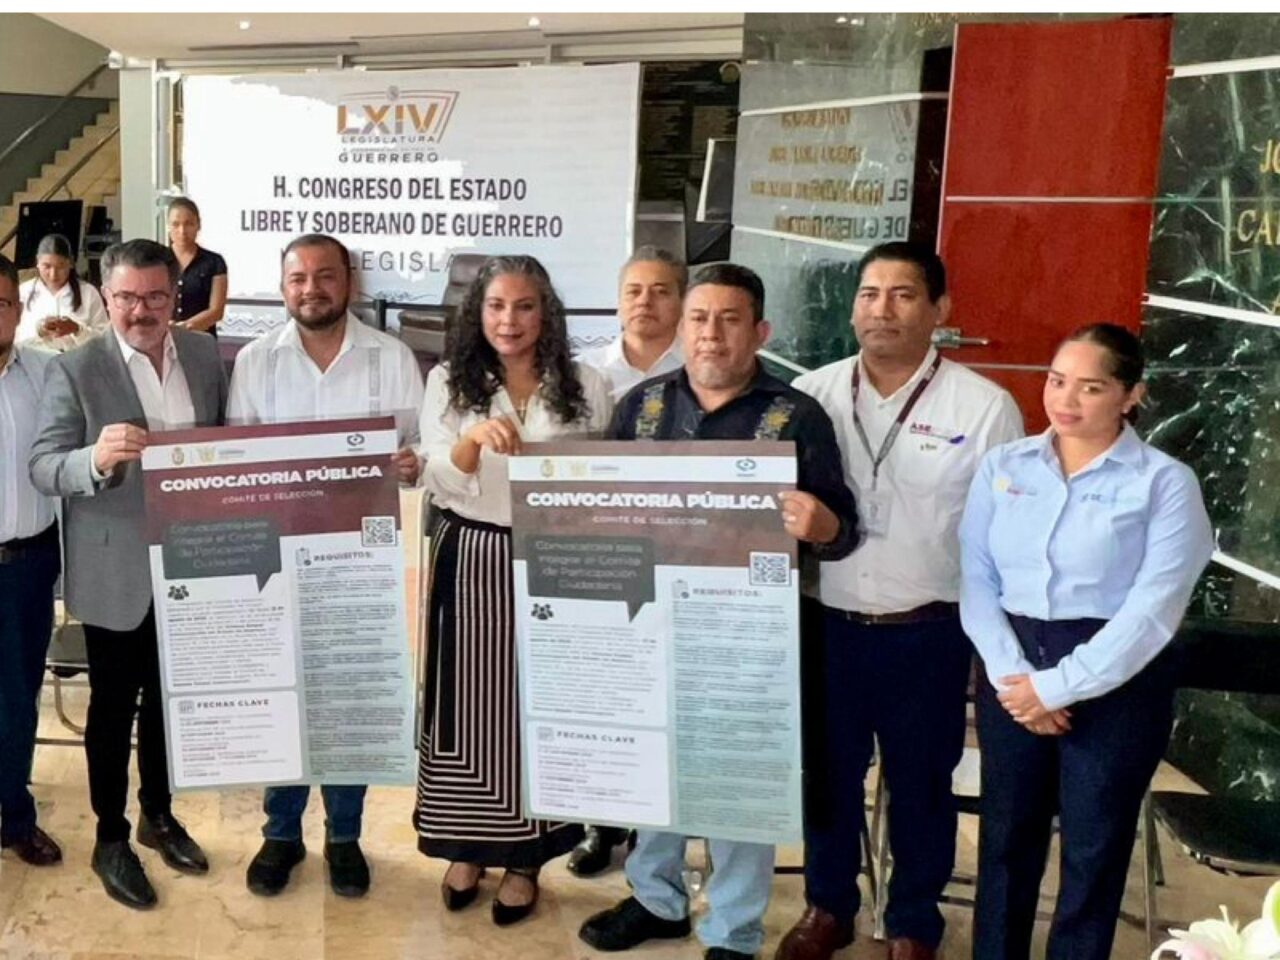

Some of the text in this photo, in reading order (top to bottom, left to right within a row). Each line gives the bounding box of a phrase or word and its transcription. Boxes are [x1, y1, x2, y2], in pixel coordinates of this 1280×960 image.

[337, 103, 439, 135] LXIV
[341, 135, 436, 144] LEGISLATURA
[338, 152, 439, 164] GUERRERO
[273, 176, 527, 202] H. CONGRESO DEL ESTADO
[240, 211, 562, 238] LIBRE Y SOBERANO DE GUERRERO
[1237, 210, 1280, 245] CA
[160, 465, 383, 492] CONVOCATORIA PÚBLICA
[526, 491, 777, 510] CONVOCATORIA PÚBLICA
